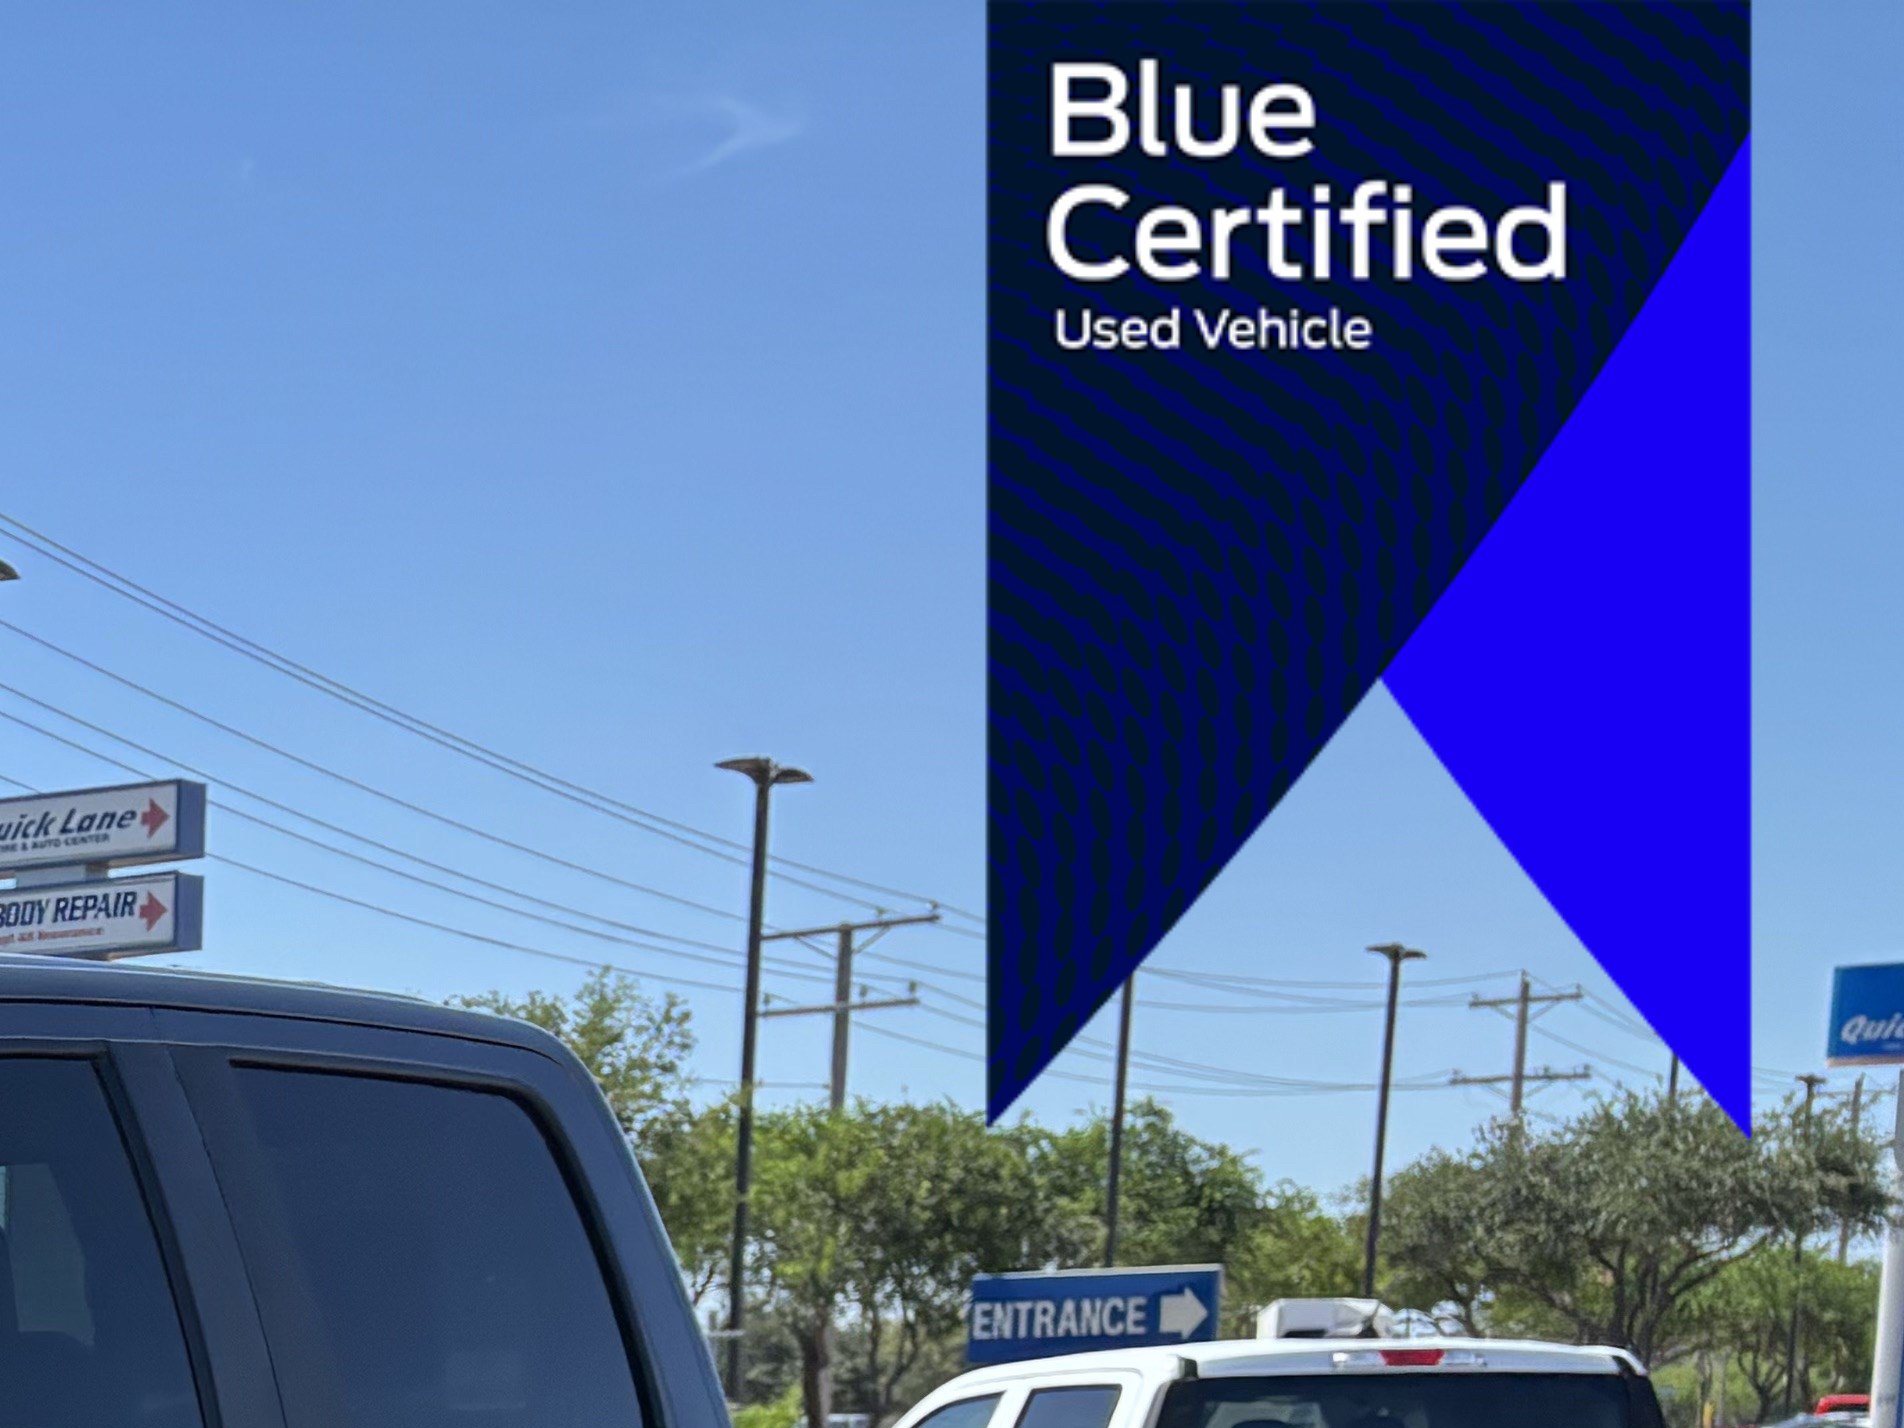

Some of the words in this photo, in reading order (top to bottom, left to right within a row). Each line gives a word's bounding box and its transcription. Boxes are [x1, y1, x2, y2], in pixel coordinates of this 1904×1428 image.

[59, 808, 138, 834] Lane
[52, 890, 138, 923] REPAIR
[972, 1297, 1148, 1340] ENTRANCE
